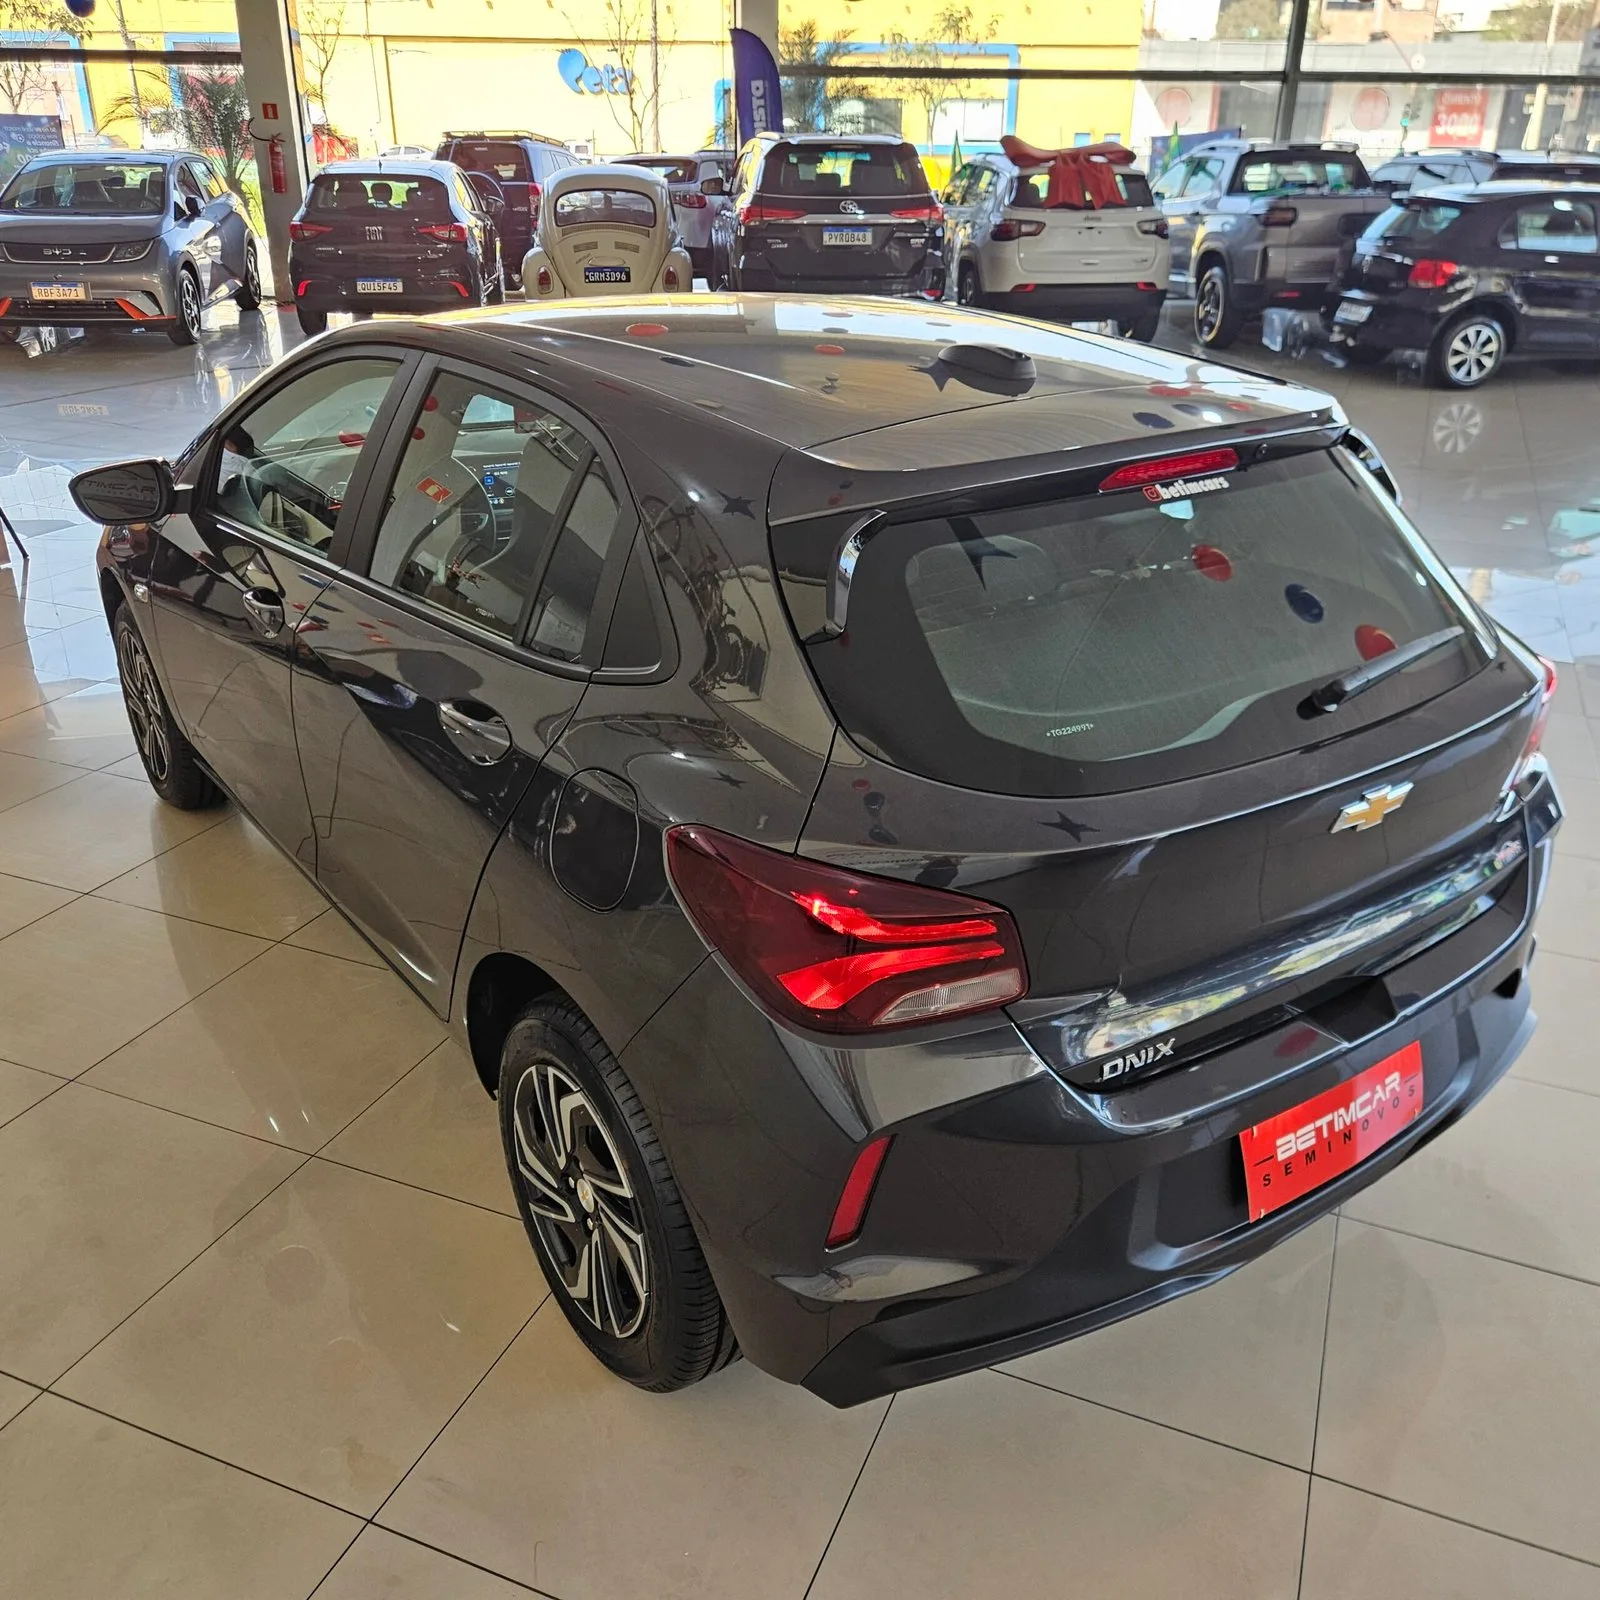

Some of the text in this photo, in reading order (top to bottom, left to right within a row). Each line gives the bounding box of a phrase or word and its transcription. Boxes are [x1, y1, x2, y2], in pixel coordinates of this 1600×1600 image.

[365, 226, 383, 240] FIAT
[37, 288, 80, 298] RBF3A71
[1155, 476, 1230, 500] betimcars
[1102, 1037, 1176, 1081] ONIX
[1275, 1071, 1401, 1162] BETIMCAR
[1263, 1085, 1416, 1188] SEMINOVOS
